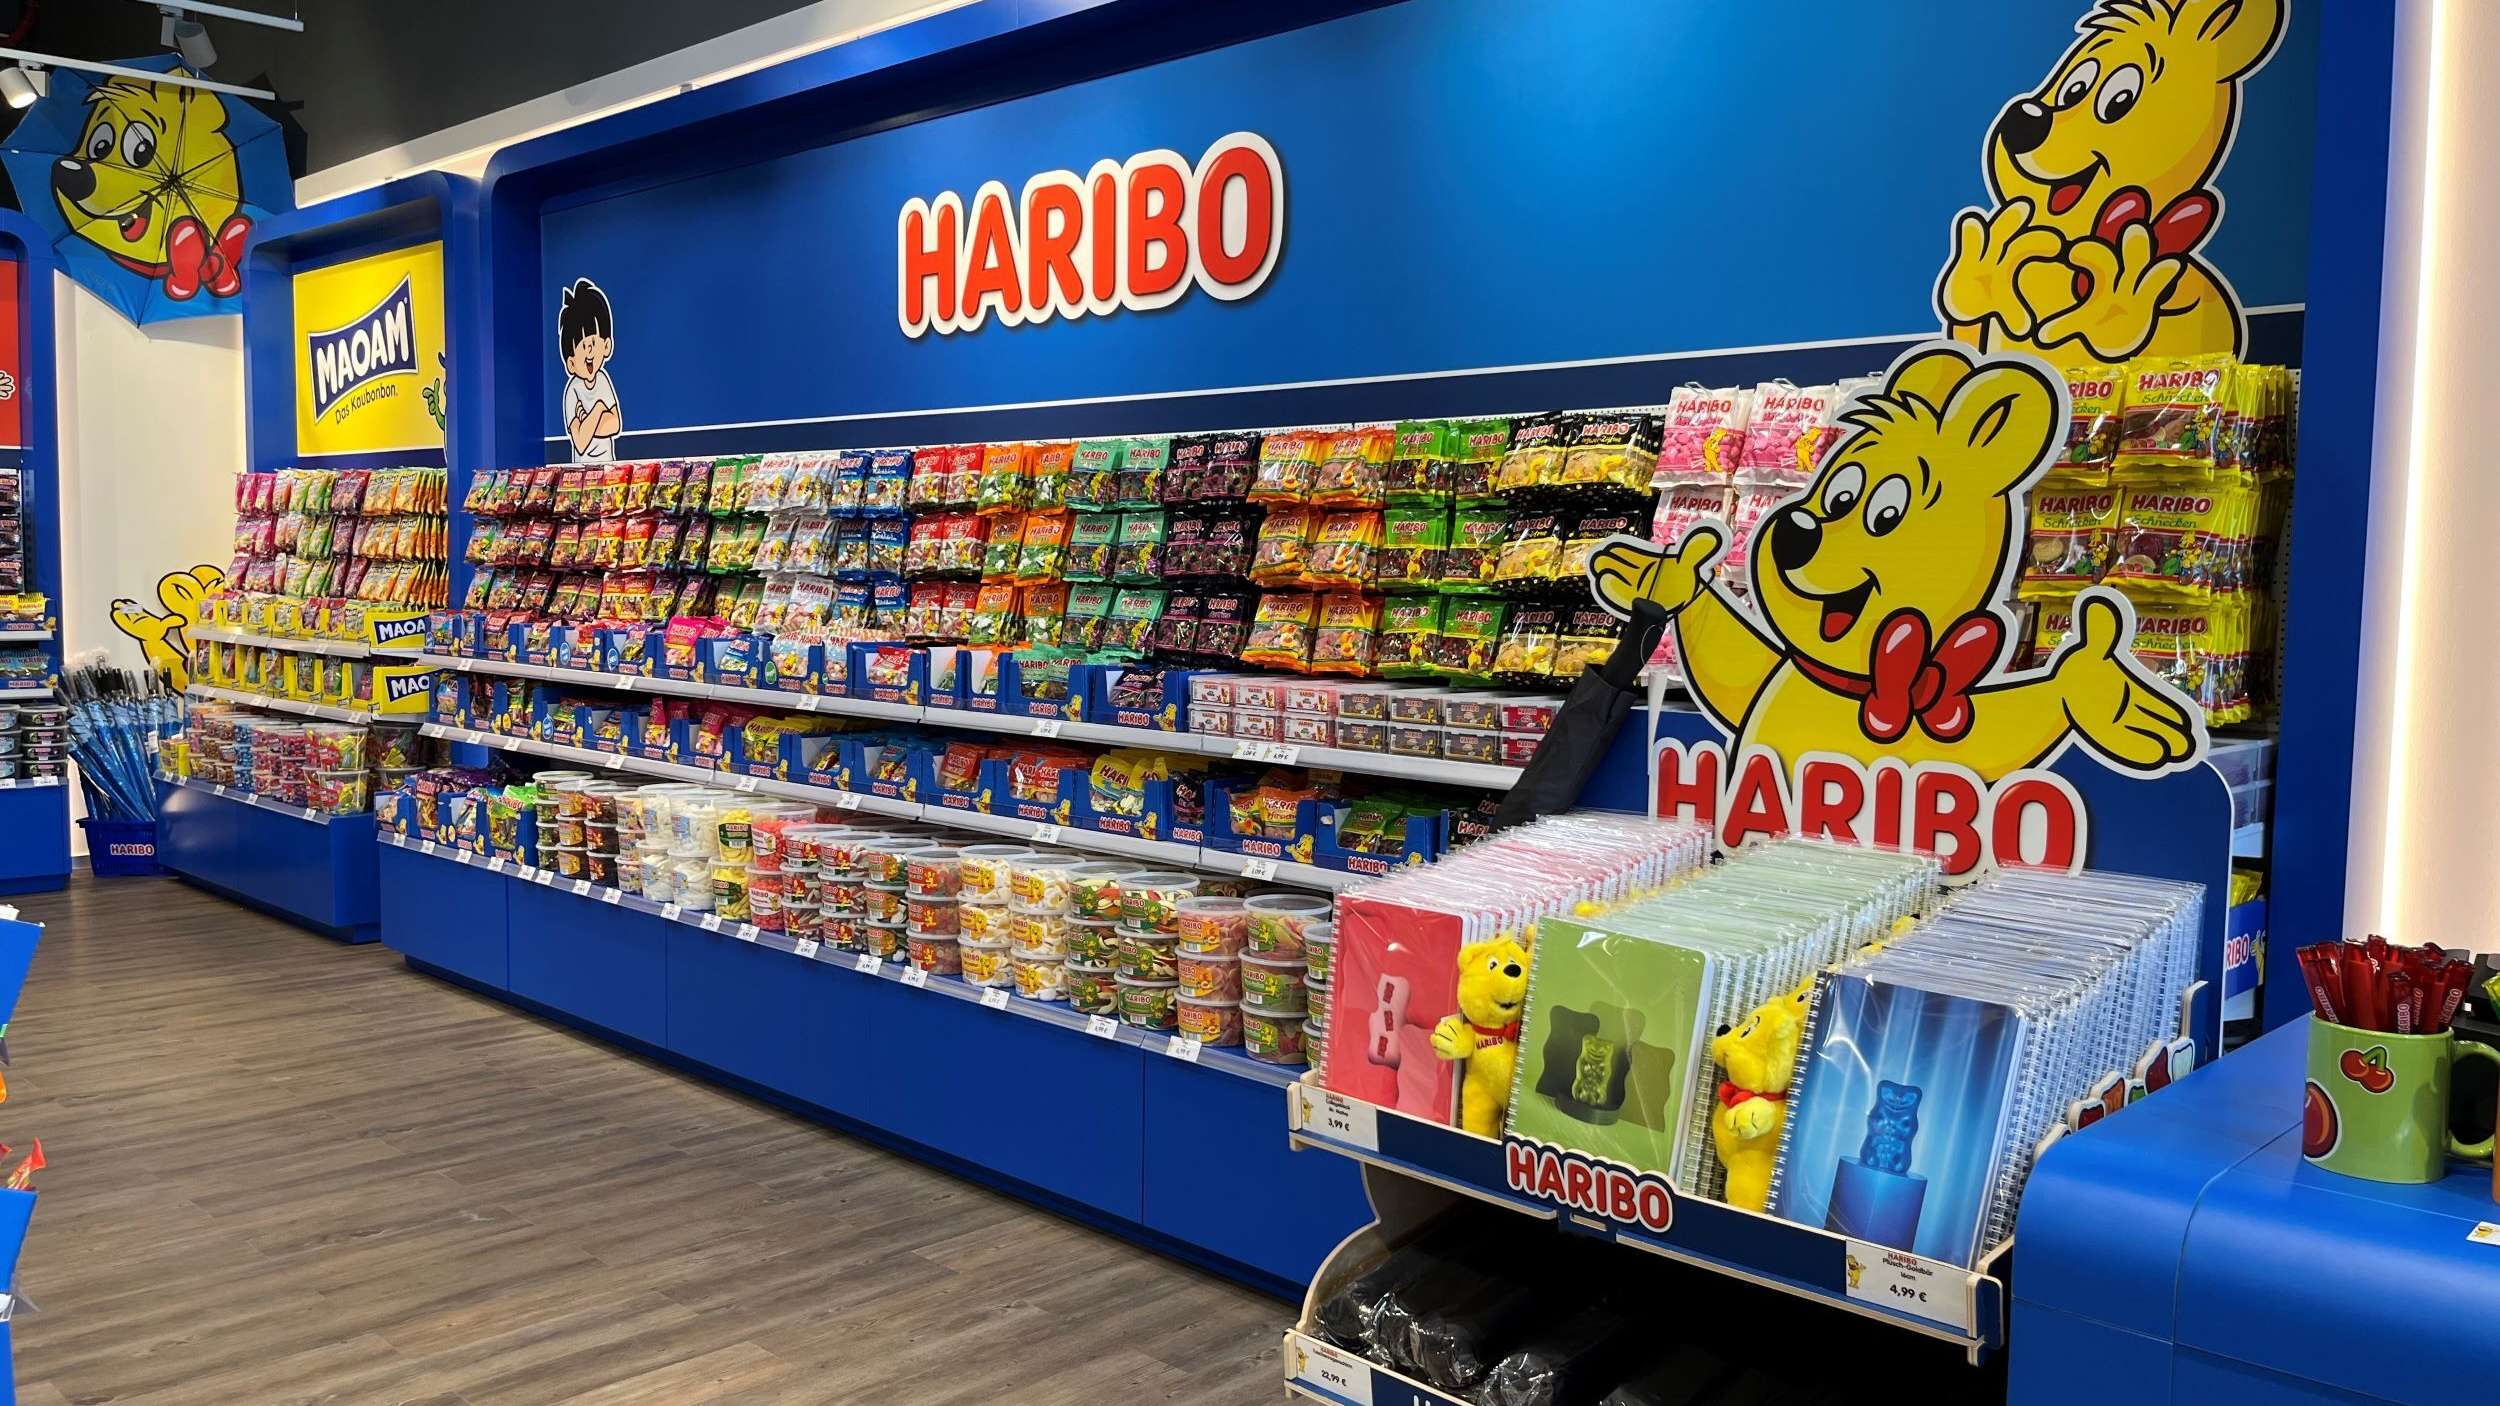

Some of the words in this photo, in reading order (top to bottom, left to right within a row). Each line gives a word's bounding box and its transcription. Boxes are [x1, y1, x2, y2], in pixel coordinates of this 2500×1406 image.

[902, 136, 1280, 333] HARIBO
[316, 301, 409, 405] MAOAM
[2138, 370, 2221, 391] HARIBO
[2068, 380, 2113, 399] RIBO
[1677, 400, 1732, 413] HARIBO
[1764, 397, 1825, 412] HARIBO
[335, 407, 349, 425] Das
[1582, 423, 1629, 437] HARIBO
[1469, 432, 1505, 447] HARIBO
[989, 453, 1017, 465] HARIBO
[1081, 451, 1109, 460] HARIBO
[1129, 449, 1161, 458] HARIBO
[1671, 496, 1722, 513] HARIBO
[2039, 495, 2112, 513] HARIBO
[2131, 495, 2212, 513] HARIBO
[1079, 523, 1109, 533] HARIBO
[1392, 522, 1427, 533] HARIBO
[1513, 516, 1554, 532] HARIBO
[1579, 517, 1627, 530] HARIBO
[2043, 517, 2102, 528] Schnecken
[2132, 517, 2197, 528] Schnecken
[1030, 526, 1060, 536] HARIBO
[798, 582, 829, 595] HARIBO
[1076, 594, 1102, 605] HARIBO
[1122, 597, 1152, 609] HARIBO
[1328, 606, 1359, 615] HARIBO
[1391, 607, 1430, 618] HARIBO
[1456, 610, 1493, 624] HARIBO
[1514, 612, 1554, 624] HARIBO
[1573, 612, 1616, 626] HARIBO
[379, 621, 425, 641] MAOA
[1019, 659, 1049, 670] HARIBO
[391, 675, 429, 698] MAO
[874, 689, 898, 700] HARIBO
[972, 698, 996, 710] HARIBO
[1029, 703, 1058, 716] HARIBO
[1118, 711, 1149, 725] HARIBO
[808, 772, 831, 785] HARIBO
[1040, 766, 1060, 778] HARI
[1102, 764, 1129, 786] HARI
[872, 783, 897, 795] HARIBO
[942, 795, 969, 808] HARIBO
[1265, 798, 1296, 810] HARIB
[1018, 805, 1047, 819] HARIBO
[1653, 743, 2081, 874] HARIBO
[1099, 817, 1131, 833] HARIBO
[1458, 821, 1489, 837] HARI
[1173, 828, 1203, 842] HARIBO
[110, 844, 154, 856] HARIBO
[1242, 839, 1282, 857] HARIBO
[1348, 856, 1388, 874] HARIBO
[2226, 933, 2249, 970] RIBO
[1126, 993, 1152, 1004] HARIBO
[1476, 1036, 1504, 1050] HARIBO
[1328, 1118, 1343, 1129] 3,99
[1508, 1143, 1671, 1231] HARIBO
[1888, 1252, 1917, 1265] HARIBO
[1890, 1284, 1915, 1298] 4,99
[1919, 1292, 1927, 1302] €
